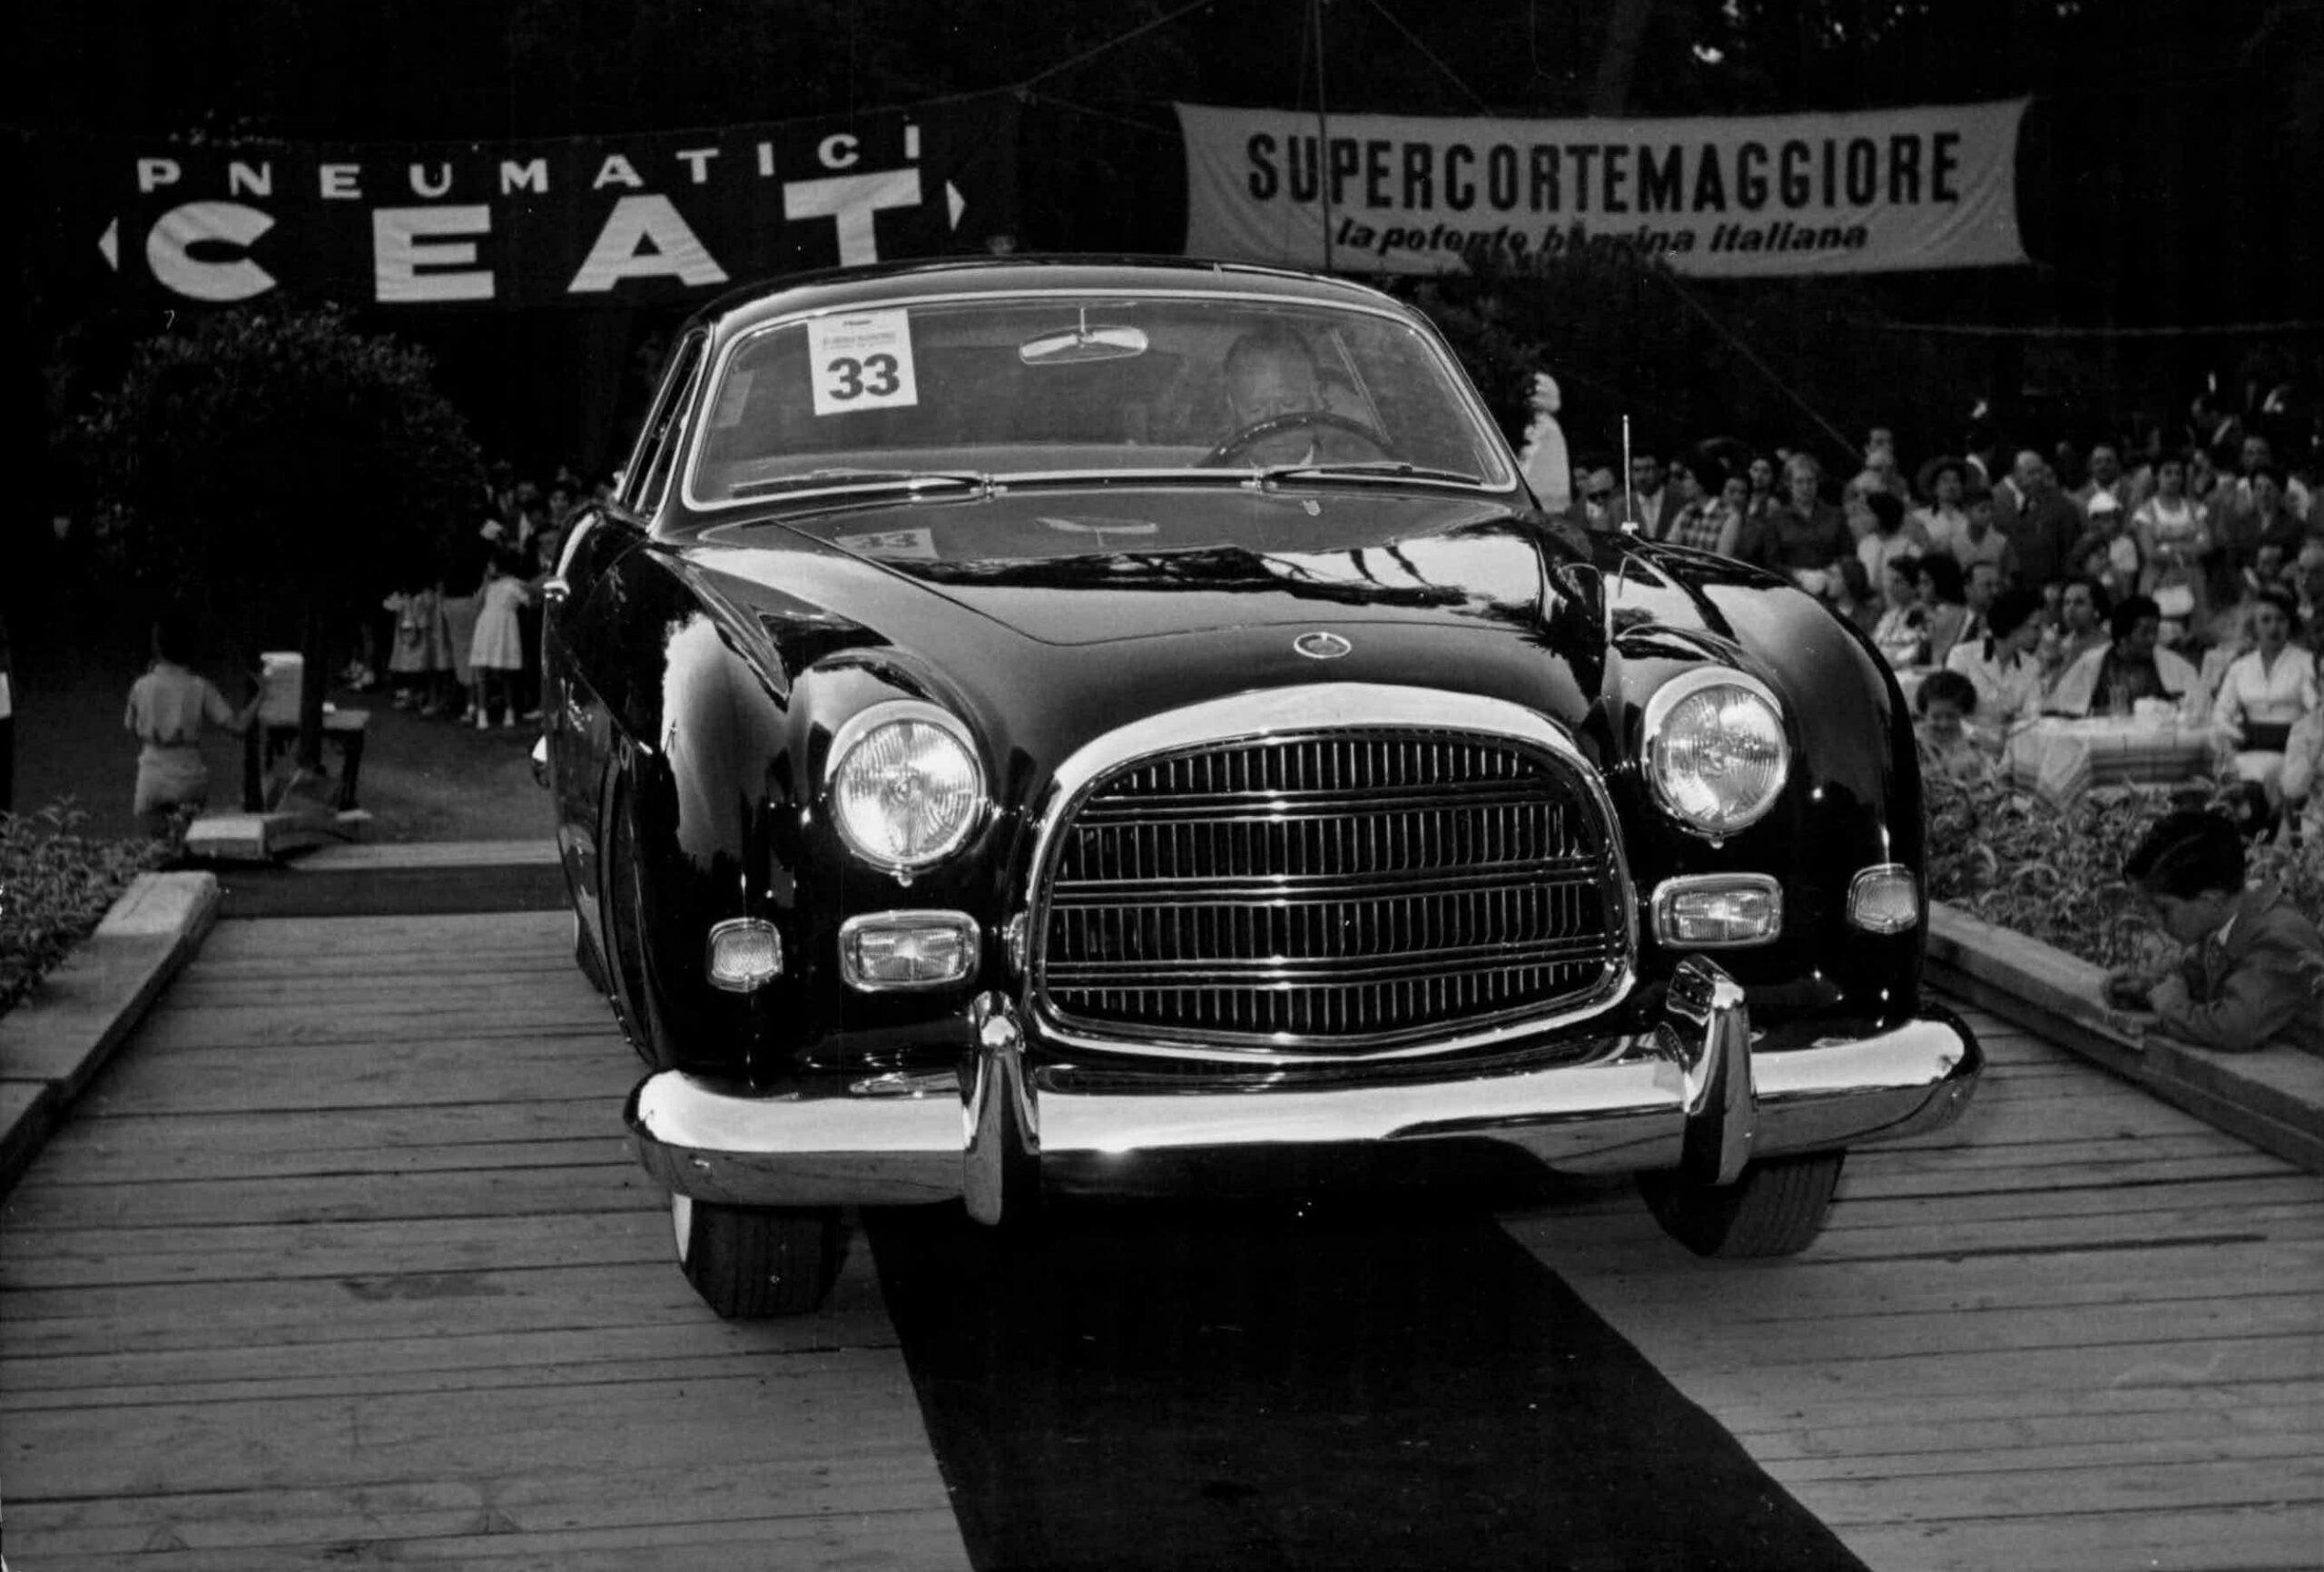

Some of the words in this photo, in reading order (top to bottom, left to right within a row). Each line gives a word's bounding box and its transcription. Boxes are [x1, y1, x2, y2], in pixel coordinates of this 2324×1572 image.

[136, 125, 921, 198] PNEUMATICI
[1246, 132, 1961, 212] SUPERCORTEMAGGIORE
[146, 168, 922, 302] CEAT
[1336, 218, 1376, 249] la
[1709, 221, 1869, 253] italiana
[827, 353, 901, 400] 33
